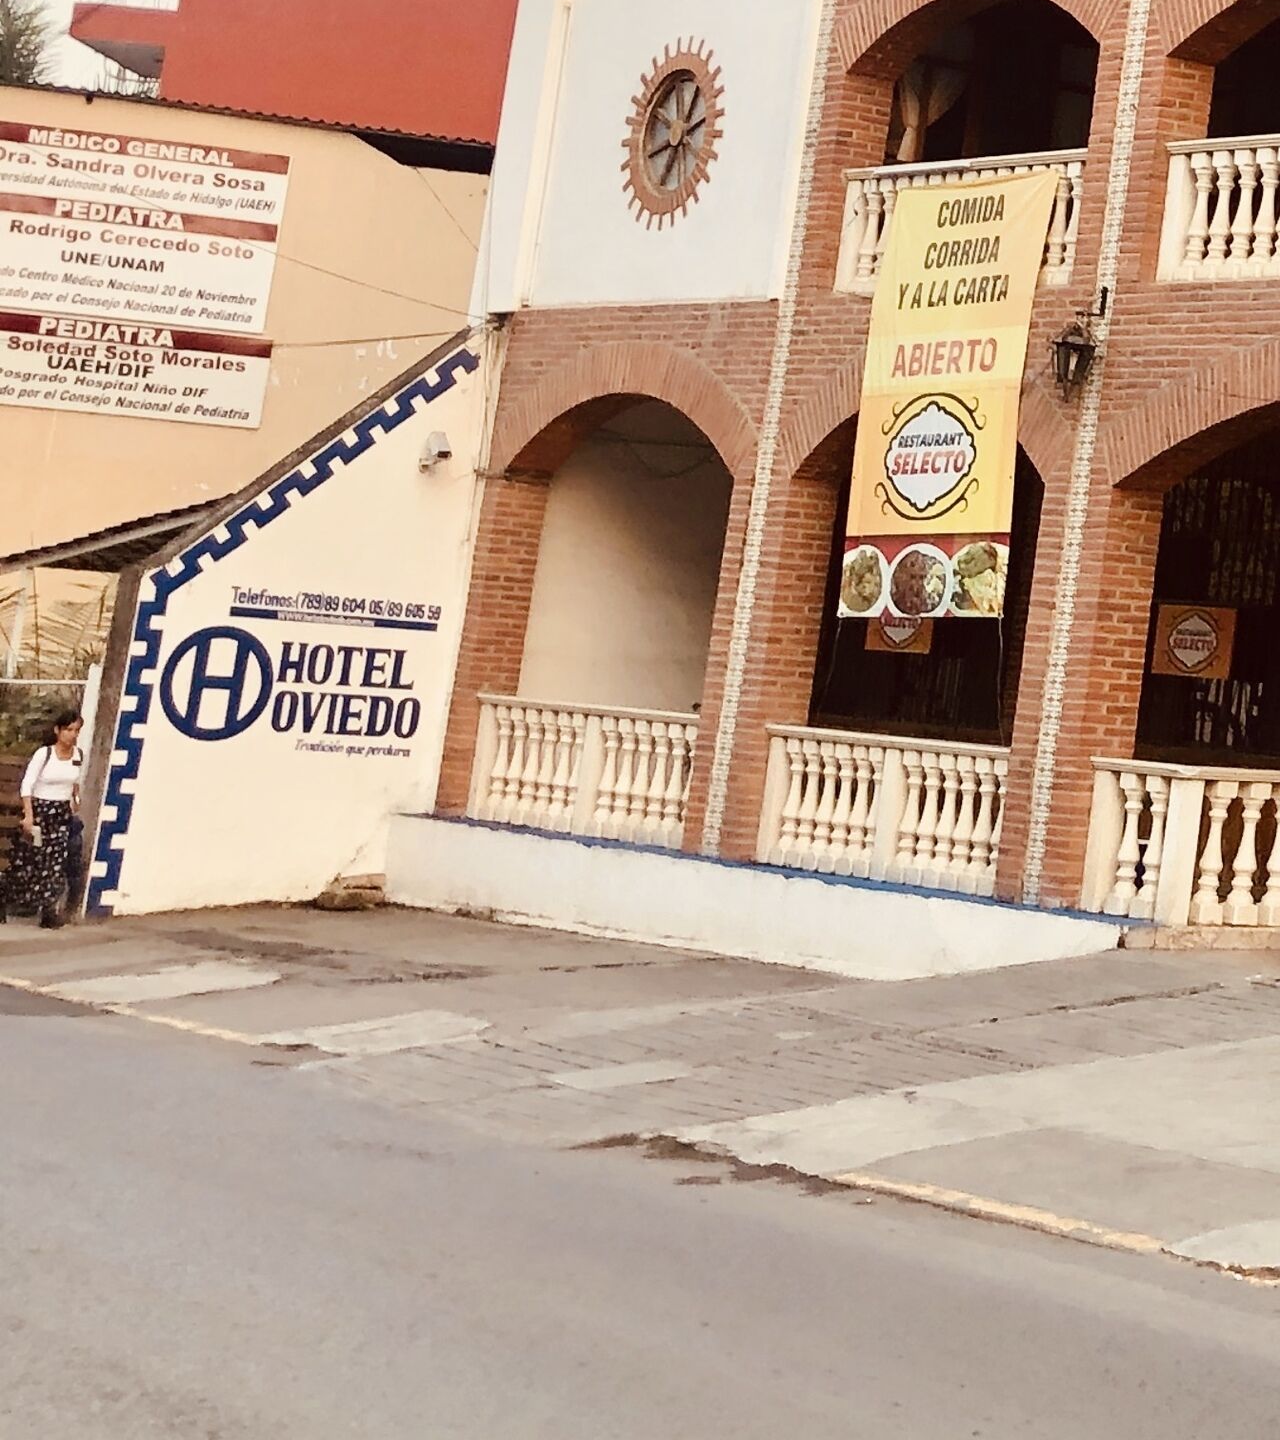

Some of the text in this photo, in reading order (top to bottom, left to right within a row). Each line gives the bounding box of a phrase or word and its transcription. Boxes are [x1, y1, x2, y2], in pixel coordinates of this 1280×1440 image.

[28, 126, 234, 167] MÉDICO GENERAL
[46, 152, 125, 176] Sandra
[133, 164, 205, 185] Olvera
[212, 173, 265, 192] Sosa
[55, 199, 185, 231] PEDIATRA
[130, 185, 170, 200] Estado
[172, 192, 187, 201] de
[190, 192, 233, 208] Hidalgo
[234, 198, 276, 213] (UAEH)
[937, 194, 1005, 228] COMIDA
[9, 219, 254, 260] Rodrigo Cerecedo Soto
[924, 236, 1000, 269] CORRIDA
[61, 250, 165, 273] UNE/UNAM
[19, 267, 58, 282] Centro
[107, 279, 160, 295] Nacional
[161, 285, 177, 297] 20
[178, 287, 193, 298] de
[196, 289, 257, 306] Noviembre
[898, 274, 1010, 310] Y A LA CARTA
[31, 291, 53, 301] por
[55, 292, 69, 302] el
[71, 293, 121, 310] Consejo
[123, 299, 179, 315] Nacional
[180, 306, 196, 317] de
[39, 317, 174, 348] PEDIATRA
[7, 336, 246, 372] Soledad Soto Morales
[47, 355, 155, 378] UAEH/DIF
[891, 337, 998, 378] ABIERTO
[17, 389, 41, 399] por
[43, 389, 57, 400] el
[60, 391, 111, 407] Consejo
[115, 397, 172, 412] Nacional
[174, 402, 190, 414] de
[74, 376, 138, 392] Hospital
[182, 386, 209, 398] DIF
[897, 432, 964, 448] RESTAURANT
[891, 450, 967, 476] SELECTO
[342, 597, 366, 613] 604
[369, 600, 403, 617] 05/89
[405, 603, 425, 619] 605
[427, 605, 442, 621] 59
[276, 641, 415, 690] HOTEL
[271, 690, 421, 739] OVIEDO
[345, 745, 366, 757] que
